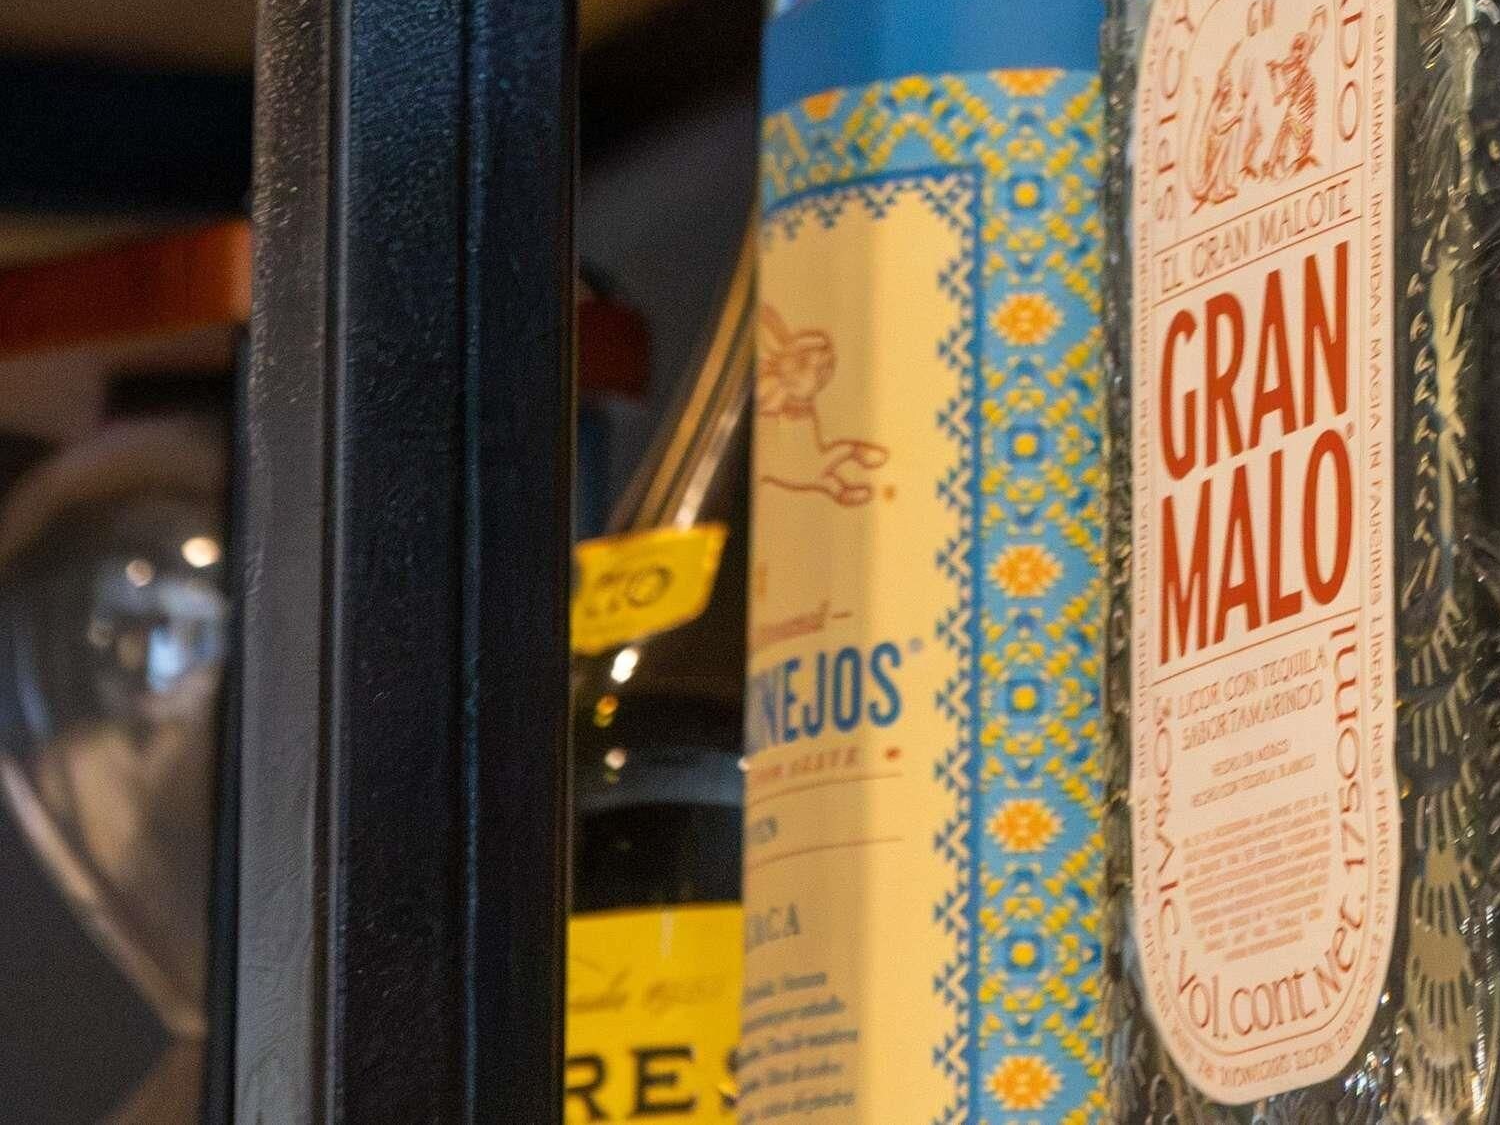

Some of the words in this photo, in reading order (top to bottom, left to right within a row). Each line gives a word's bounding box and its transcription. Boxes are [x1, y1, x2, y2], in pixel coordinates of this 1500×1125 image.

[1190, 220, 1252, 277] GRAN
[1258, 178, 1352, 252] MALOTE
[1159, 240, 1351, 481] GRAN
[1159, 428, 1353, 666] MALO
[565, 1047, 740, 1123] RE
